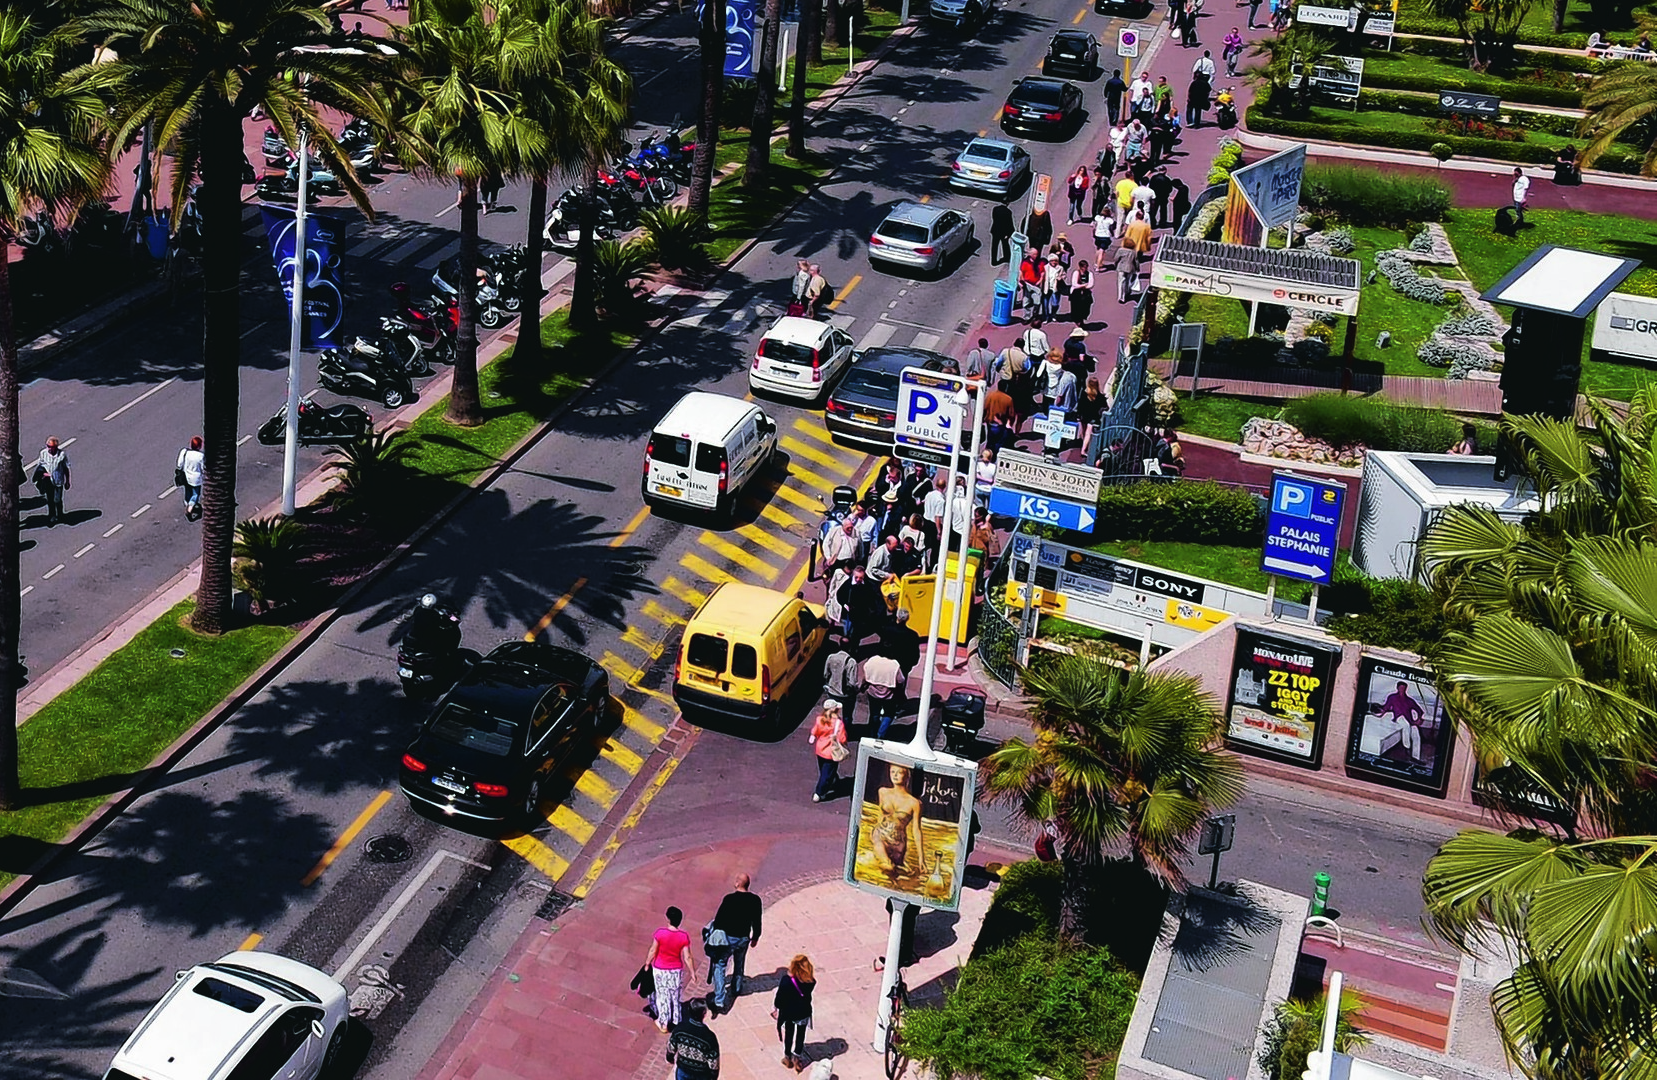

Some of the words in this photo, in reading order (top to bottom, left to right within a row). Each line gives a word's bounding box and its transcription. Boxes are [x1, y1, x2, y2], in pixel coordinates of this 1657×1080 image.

[1288, 292, 1344, 307] CERCLE
[908, 389, 939, 423] P
[906, 425, 949, 441] PUBLIC
[1013, 463, 1048, 478] JOHN
[1050, 472, 1059, 481] &
[1063, 475, 1098, 489] JOHN
[1280, 485, 1305, 510] P
[1311, 513, 1334, 525] PUBLIC
[1281, 526, 1320, 543] PALAIS
[1268, 535, 1330, 557] STEPHANIE
[1142, 576, 1198, 597] SONY
[1268, 669, 1289, 687] ZZ
[1291, 673, 1320, 691] TOP
[1374, 665, 1406, 679] Claude
[1276, 687, 1310, 703] IGGY
[1271, 701, 1315, 716] STOOGES
[929, 795, 949, 806] Dior
